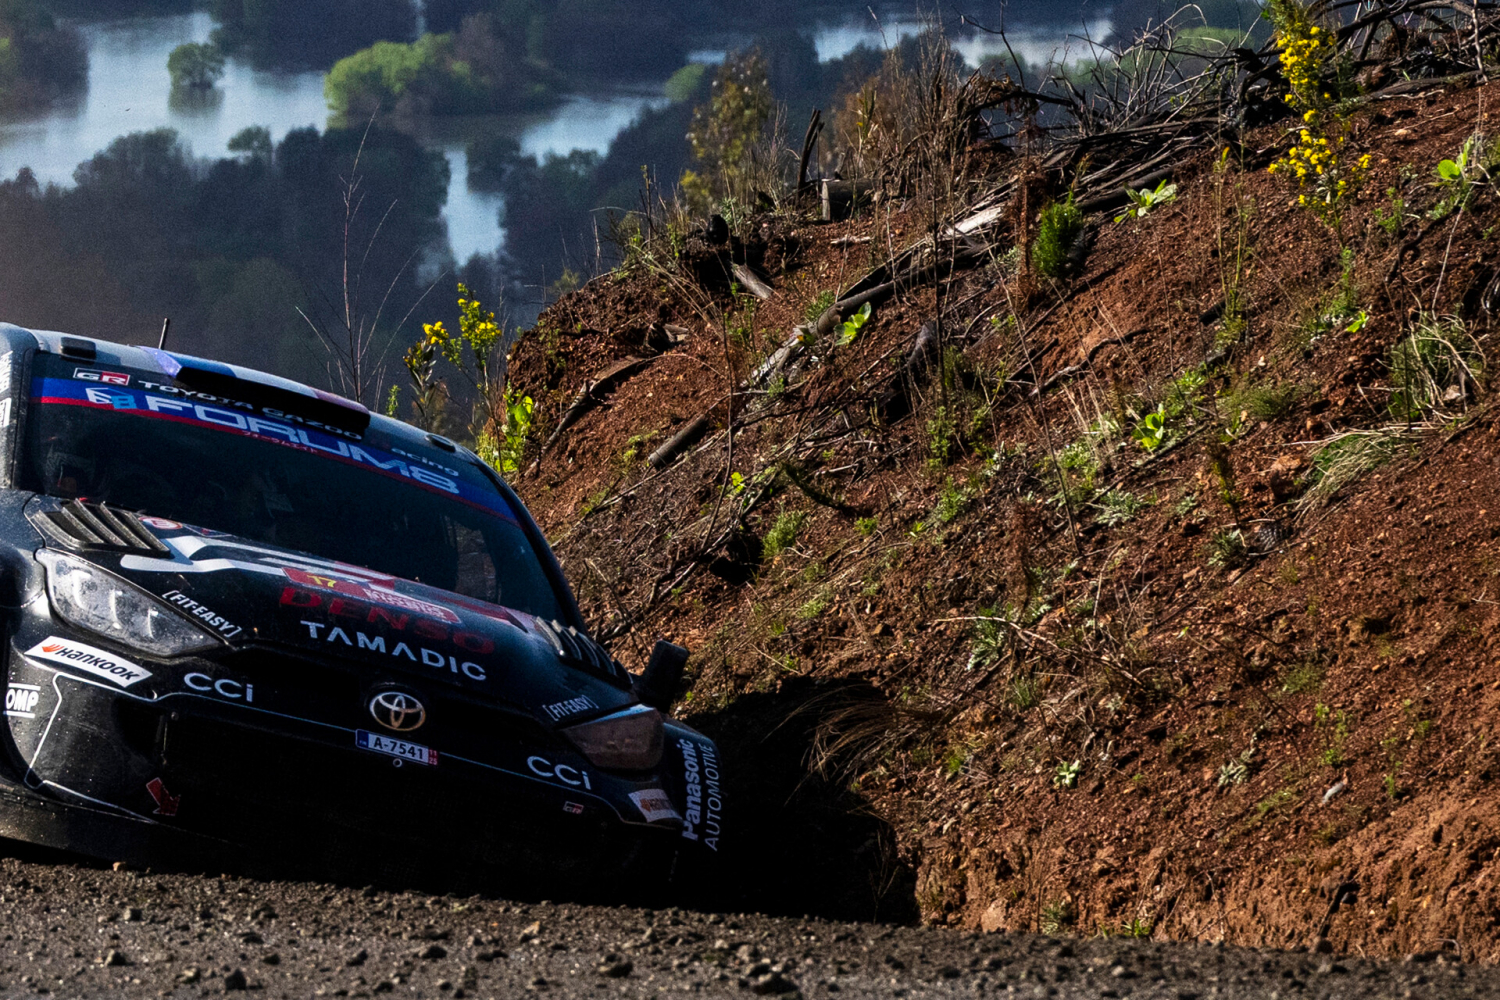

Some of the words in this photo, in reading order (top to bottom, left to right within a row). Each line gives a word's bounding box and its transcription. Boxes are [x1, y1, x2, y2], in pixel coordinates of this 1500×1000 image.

[76, 372, 127, 385] GR
[138, 380, 254, 410] TOYOTA
[262, 407, 363, 440] GAZOO
[372, 441, 460, 477] acing
[145, 395, 460, 494] FORUM8
[306, 574, 337, 588] 17
[279, 586, 495, 654] DENSO
[300, 620, 487, 681] TAMADIC
[6, 688, 39, 711] OMP
[373, 737, 424, 760] A-7541
[676, 739, 701, 840] Panasonic
[698, 743, 722, 851] AUTOMOTIVE
